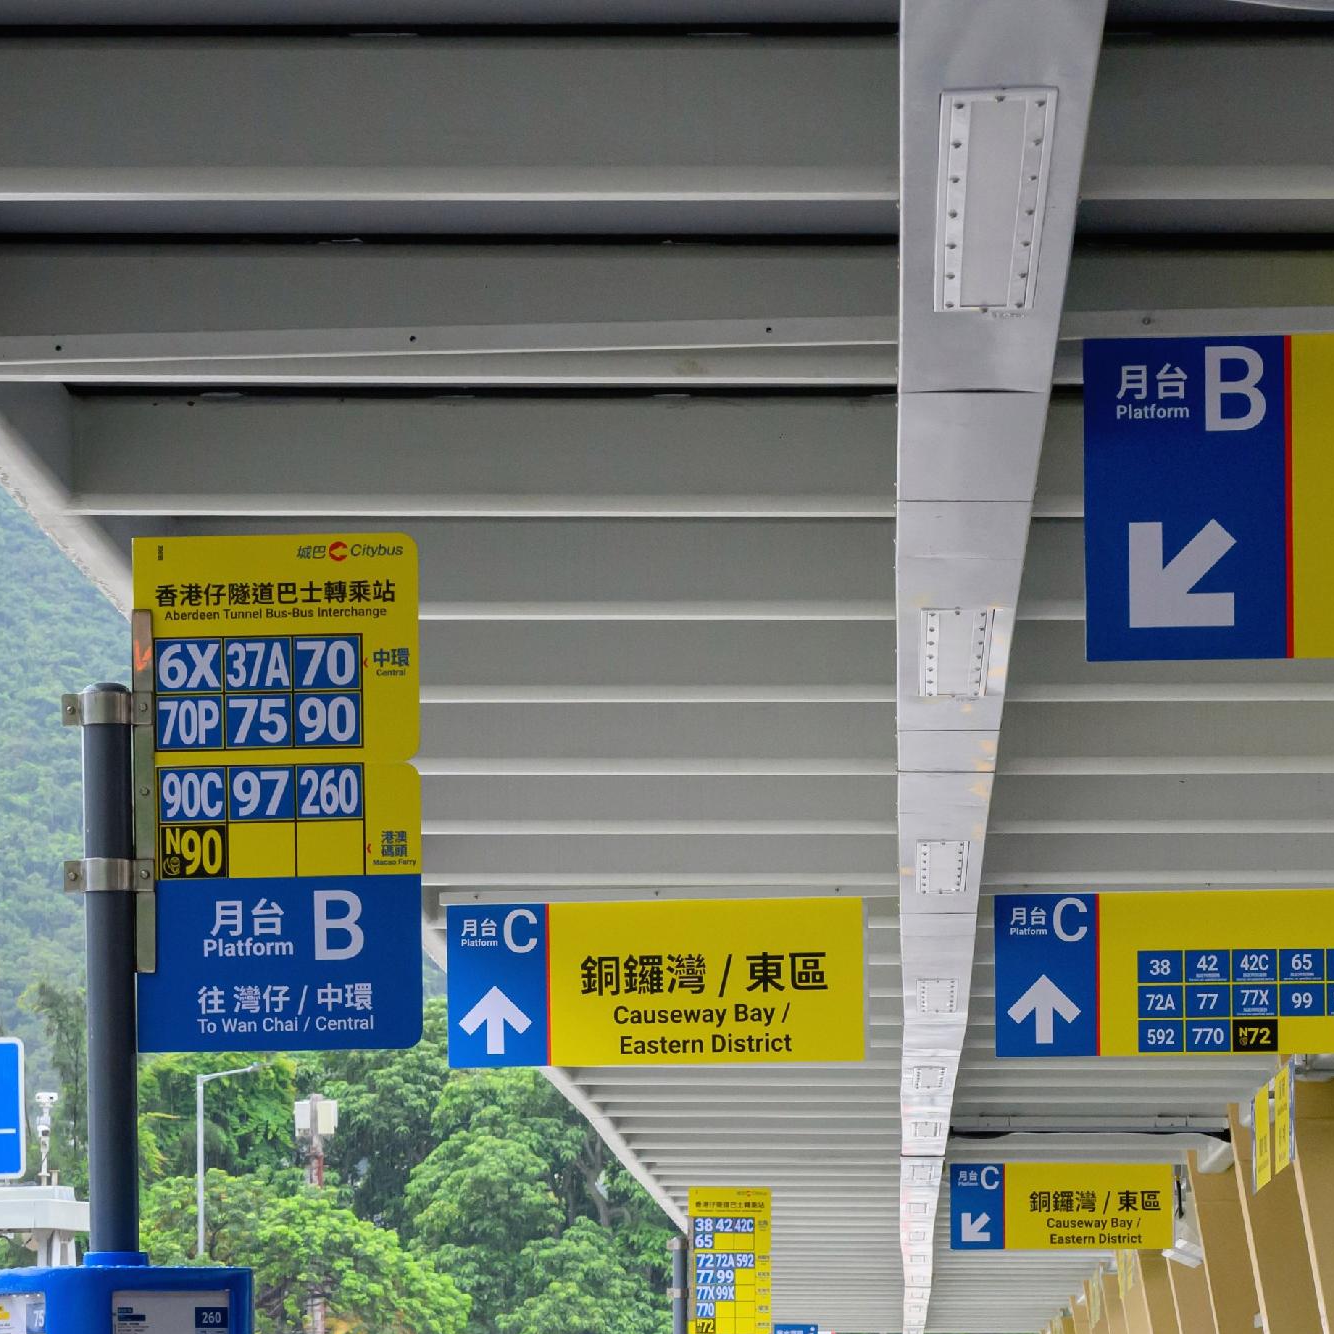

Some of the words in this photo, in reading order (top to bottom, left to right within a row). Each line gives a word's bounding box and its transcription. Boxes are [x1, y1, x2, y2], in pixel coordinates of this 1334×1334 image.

[1115, 364, 1188, 400] 月台
[1203, 346, 1267, 433] B
[1115, 402, 1190, 422] Platform
[297, 545, 326, 560] 城巴
[351, 543, 403, 561] Citybus
[155, 579, 396, 608] 香港仔隧道巴士轉乘站
[164, 608, 220, 621] Aberdeen
[223, 607, 262, 619] Tunnel
[266, 606, 314, 618] Bus-Bus
[317, 605, 387, 619] Interchange
[158, 643, 220, 689] 6X
[227, 641, 291, 688] 37A
[296, 640, 356, 686] 70
[372, 648, 410, 668] 中環
[376, 668, 406, 677] Central
[159, 699, 219, 746] 70P
[228, 698, 288, 743] 75
[298, 696, 356, 742] 90
[162, 772, 223, 818] 90C
[233, 770, 290, 816] 97
[300, 768, 358, 815] 260
[381, 830, 407, 844] 港澳
[381, 844, 408, 858] 碼頭
[398, 858, 417, 867] Ferry
[210, 898, 285, 937] 月台
[313, 889, 365, 961] B
[1010, 907, 1047, 926] 月台
[1052, 897, 1088, 942] C
[461, 918, 497, 938] 月台
[502, 909, 538, 954] C
[1010, 927, 1047, 936] Platform
[203, 938, 294, 958] Platform
[461, 938, 498, 948] Platform
[580, 954, 706, 996] 銅鑼灣
[718, 953, 733, 998] /
[745, 951, 829, 992] 東區
[1149, 959, 1171, 976] 38
[1196, 955, 1218, 972] 42
[1240, 954, 1269, 971] 42C
[1291, 954, 1312, 971] 65
[198, 986, 225, 1015] 往
[233, 985, 290, 1014] 灣仔
[298, 985, 309, 1015] /
[317, 982, 373, 1012] 中環
[1146, 994, 1175, 1011] 72A
[1196, 993, 1218, 1010] 77
[1240, 989, 1269, 1006] 77X
[1291, 992, 1313, 1009] 99
[197, 1018, 216, 1033] To
[221, 1018, 257, 1033] Wan
[262, 1017, 298, 1032] Chai
[303, 1018, 310, 1032] /
[315, 1015, 374, 1031] Central
[613, 1005, 726, 1028] Causeway
[734, 1004, 774, 1027] Bay
[780, 1003, 791, 1024] /
[620, 1034, 704, 1055] Eastern
[712, 1032, 792, 1053] District
[1147, 1029, 1175, 1045] 592
[1192, 1028, 1224, 1045] 770
[1239, 1027, 1271, 1044] N72
[980, 1165, 1000, 1191] C
[1030, 1190, 1097, 1213] 銅鑼灣
[1102, 1190, 1112, 1215] /
[1117, 1189, 1162, 1212] 東區
[695, 1218, 713, 1232] 38
[715, 1218, 733, 1232] 42
[734, 1218, 754, 1232] 42C
[1046, 1217, 1108, 1230] Causeway
[1111, 1217, 1132, 1229] Bay
[694, 1234, 713, 1248] 65
[1050, 1233, 1095, 1245] Eastern
[1099, 1232, 1143, 1244] District
[697, 1254, 714, 1268] 72
[716, 1254, 734, 1268] 72A
[736, 1254, 755, 1268] 592
[697, 1271, 714, 1284] 77
[717, 1270, 734, 1284] 99
[696, 1286, 715, 1300] 77X
[716, 1286, 735, 1300] 99X
[33, 1309, 45, 1328] 75
[202, 1311, 222, 1324] 260
[697, 1303, 715, 1317] 770
